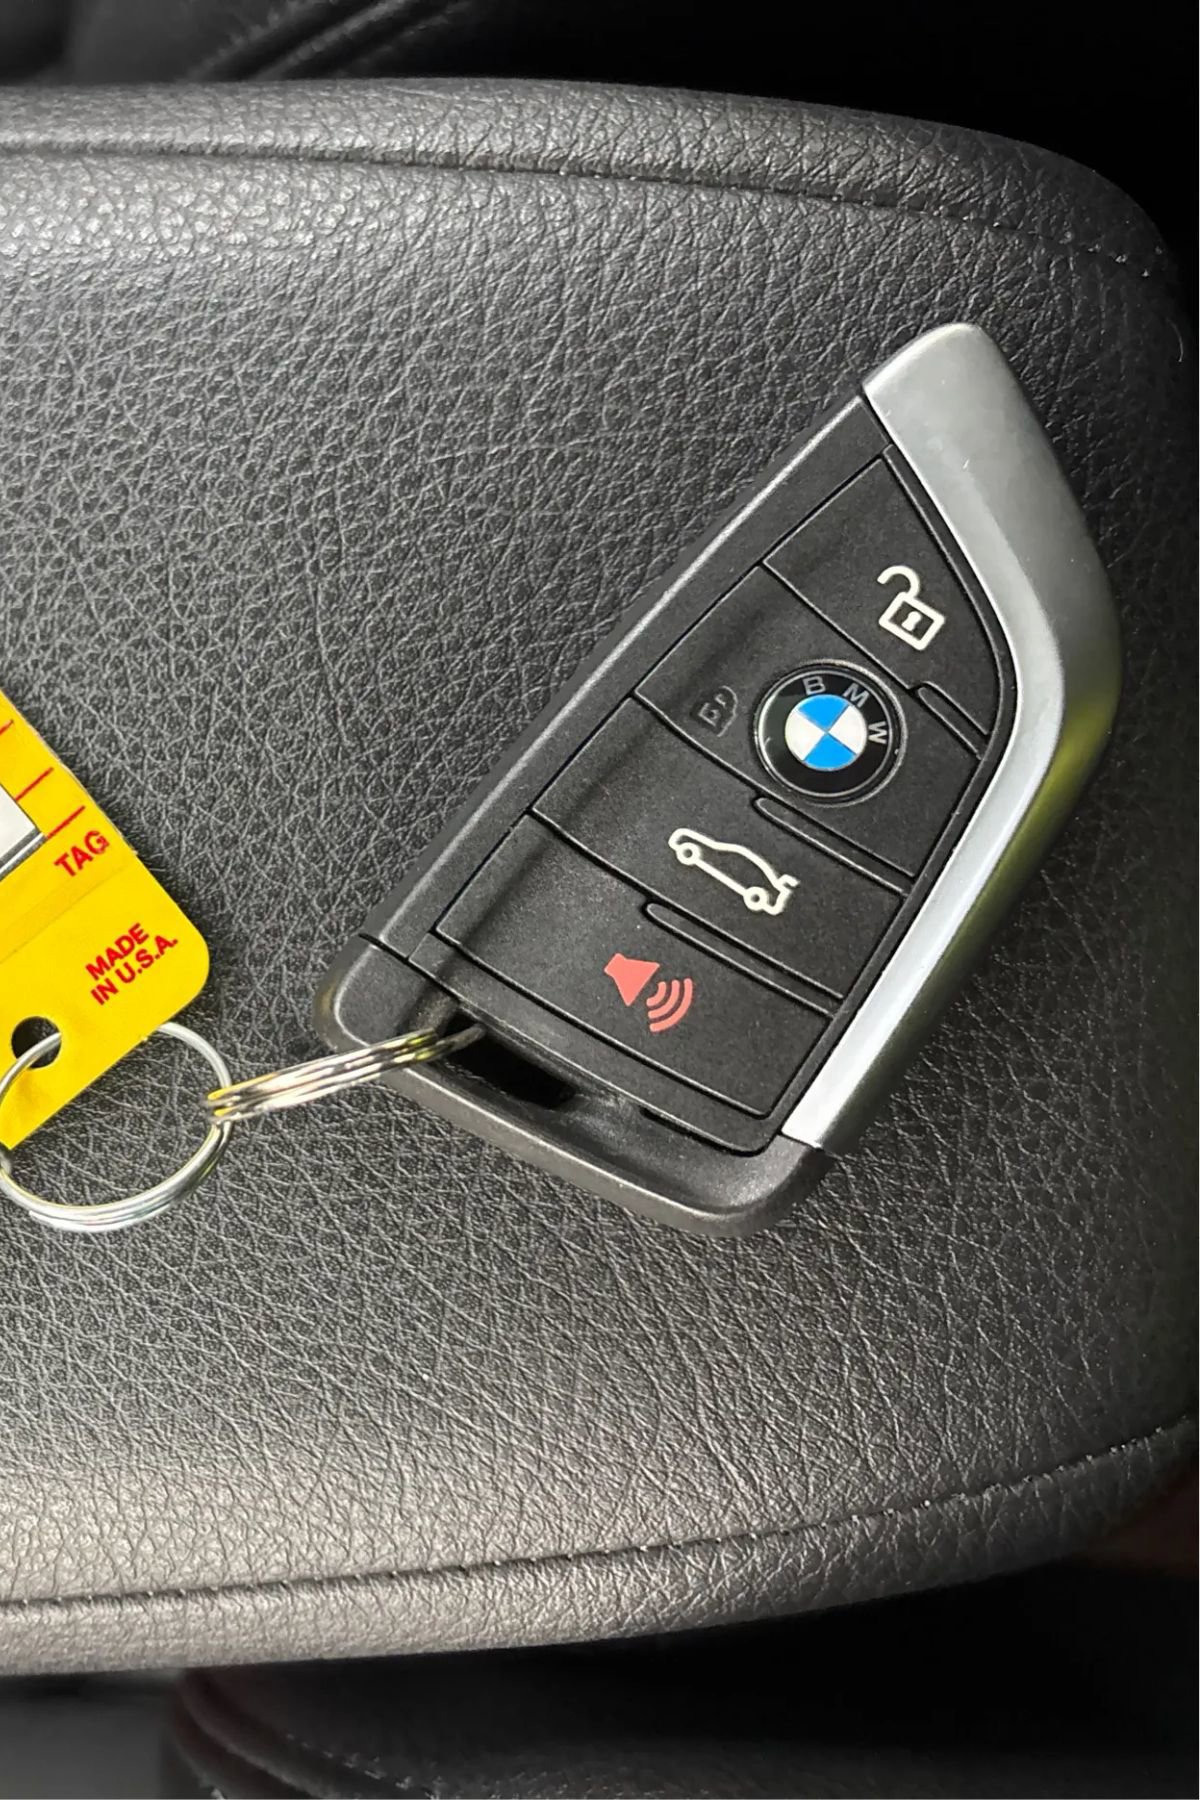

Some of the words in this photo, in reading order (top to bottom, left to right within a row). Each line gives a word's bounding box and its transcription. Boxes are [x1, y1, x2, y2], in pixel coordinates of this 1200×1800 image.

[803, 676, 887, 745] BMW
[54, 830, 110, 877] TAG
[85, 923, 149, 981] MADE
[90, 978, 118, 1005] IN
[115, 935, 178, 984] U.S.A.
